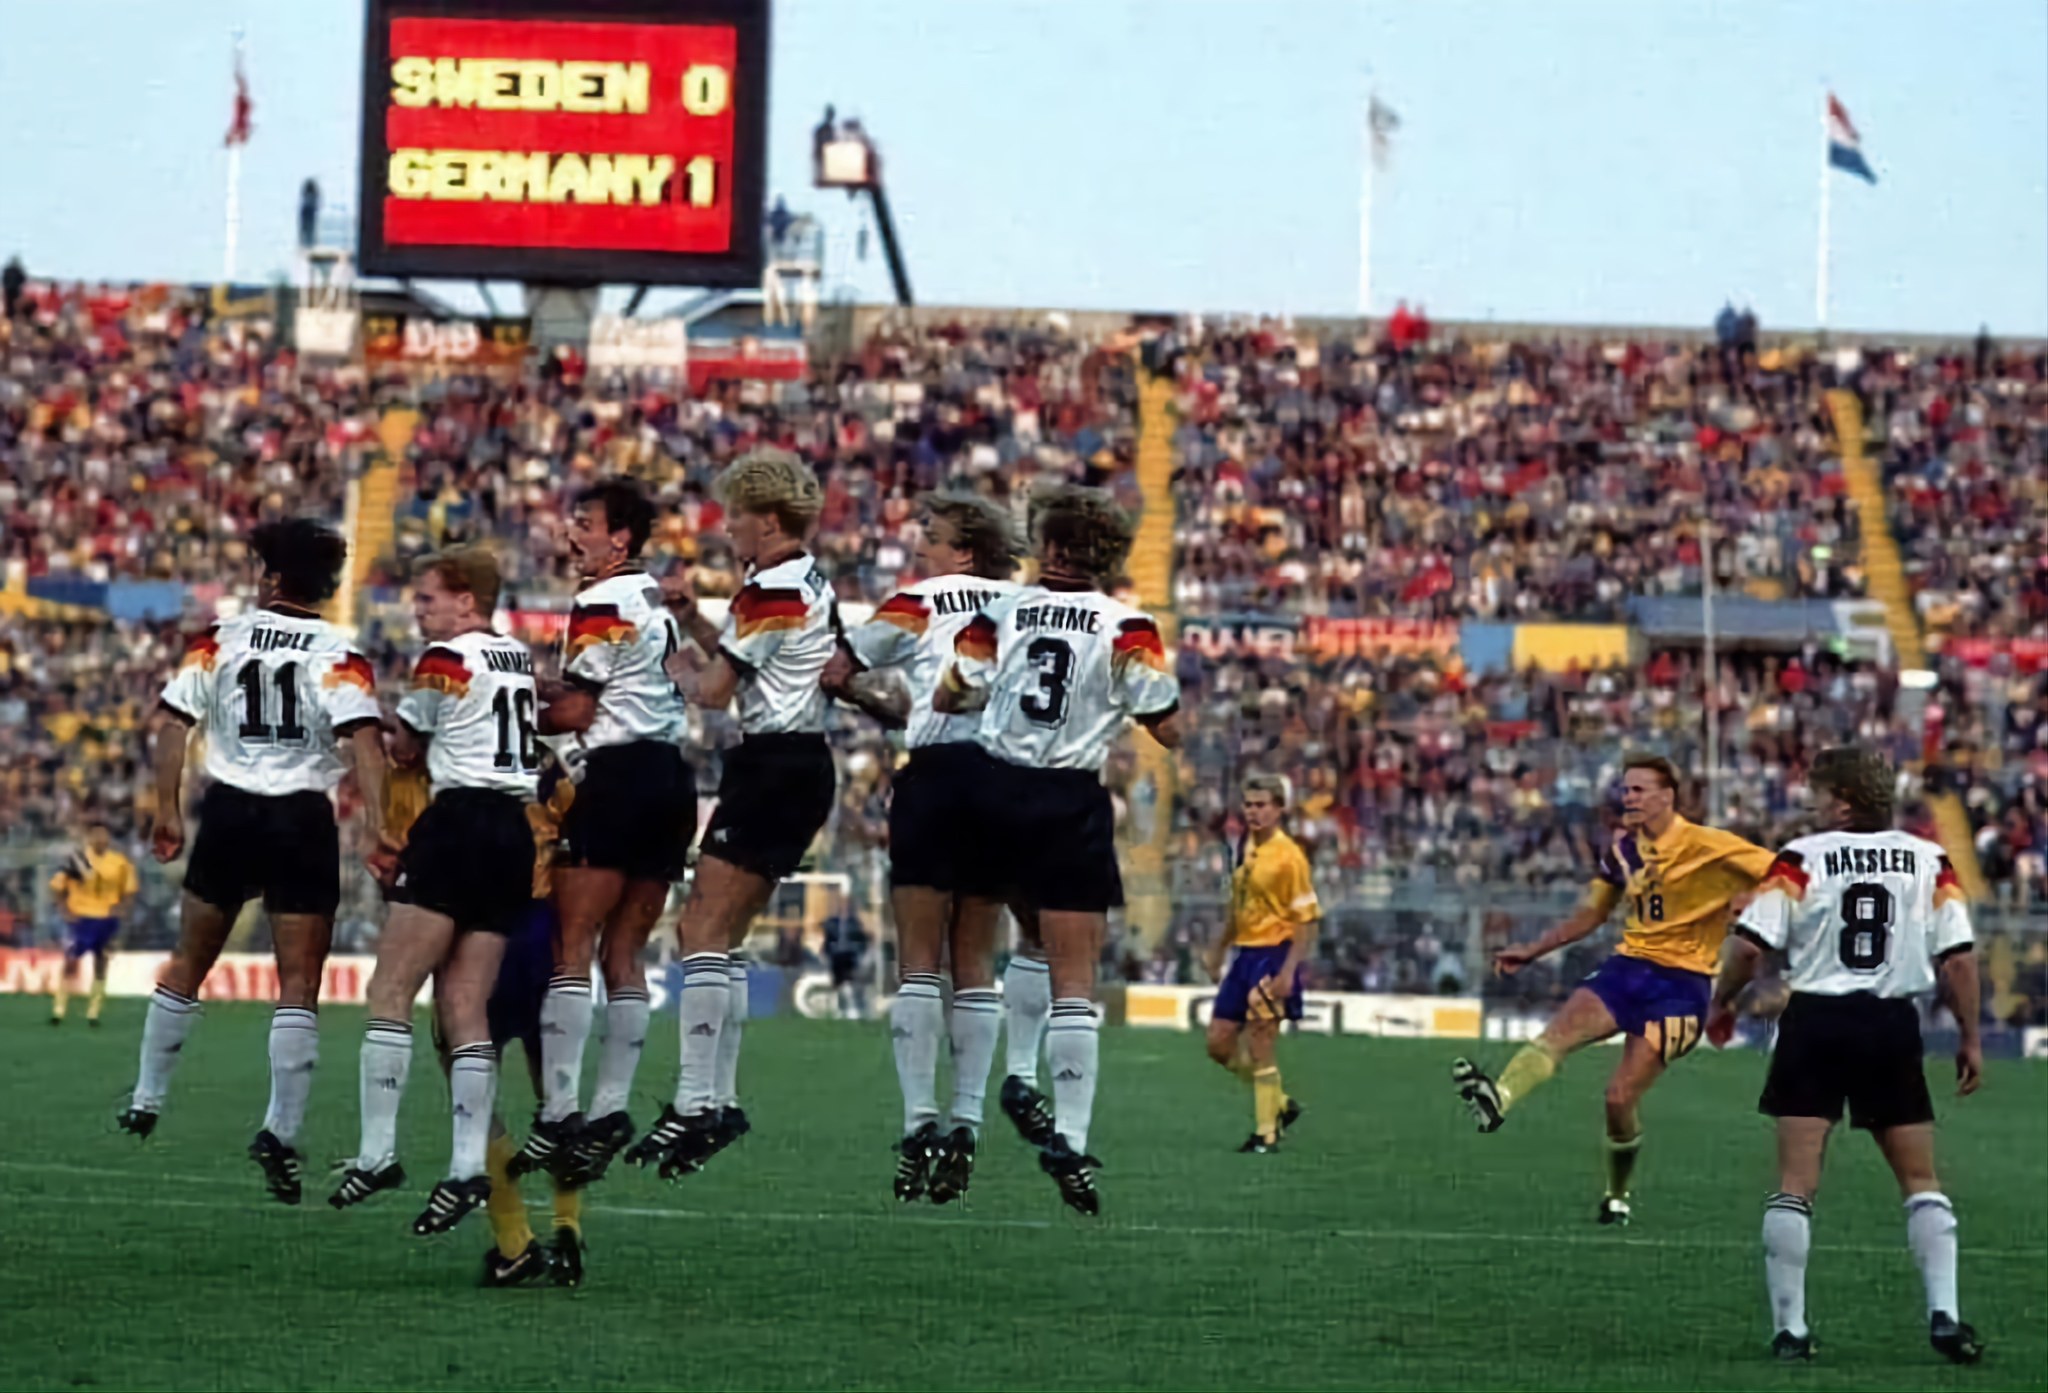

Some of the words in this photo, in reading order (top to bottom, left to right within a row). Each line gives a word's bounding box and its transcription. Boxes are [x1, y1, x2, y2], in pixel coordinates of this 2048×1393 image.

[391, 57, 649, 113] SWEDEN
[682, 64, 727, 116] 0
[388, 147, 675, 206] GERMANY
[685, 155, 714, 208] 1
[1015, 604, 1101, 634] BREHME
[237, 659, 304, 739] 11
[1020, 636, 1074, 729] 3
[492, 685, 539, 770] 16
[1635, 893, 1664, 922] 18
[1839, 882, 1893, 972] 8
